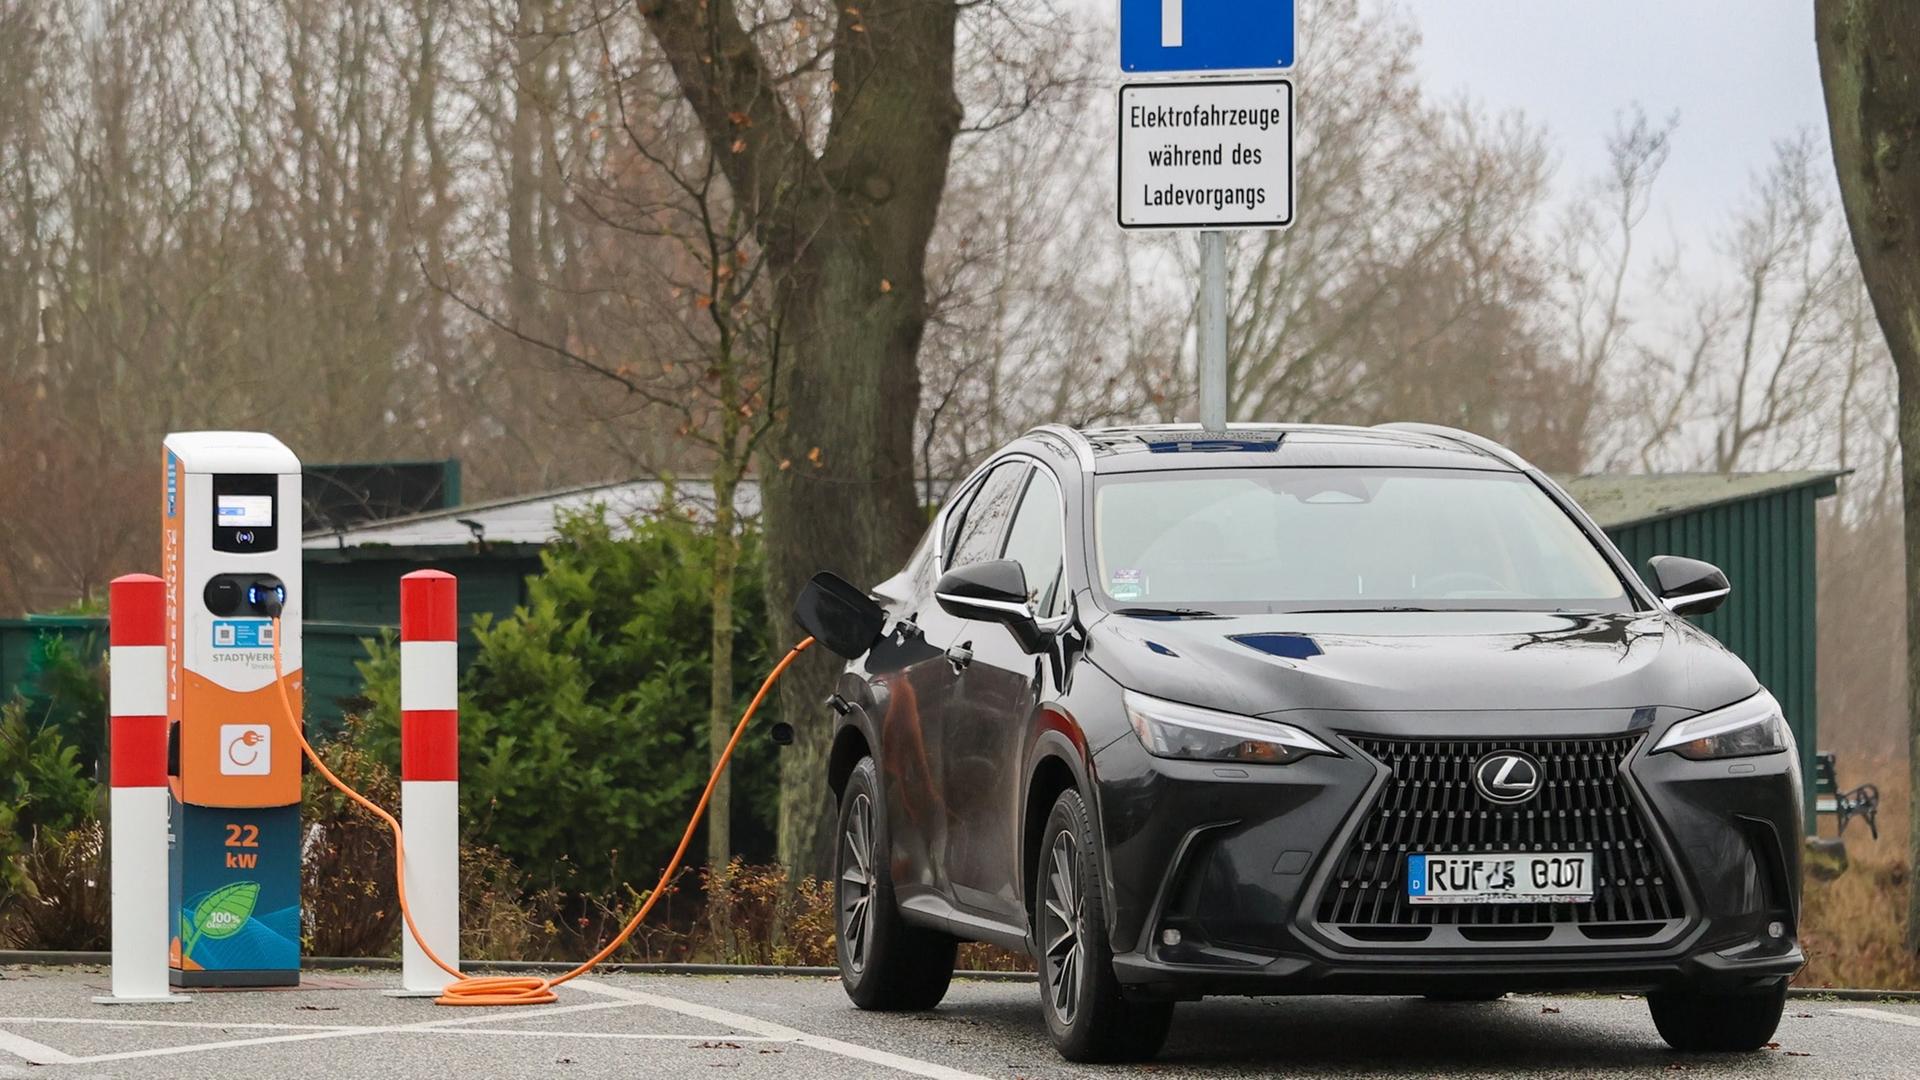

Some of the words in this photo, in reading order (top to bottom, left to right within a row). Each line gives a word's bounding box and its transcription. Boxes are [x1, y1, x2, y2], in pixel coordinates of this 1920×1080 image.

[1131, 104, 1280, 131] Elektrofahrzeuge
[1148, 143, 1222, 166] während
[1232, 143, 1262, 165] des
[1144, 184, 1265, 211] Ladevorgangs
[212, 652, 282, 668] STADTWERK
[224, 823, 259, 848] 22
[225, 852, 258, 869] kW
[1412, 879, 1421, 890] D
[210, 911, 241, 924] 100%
